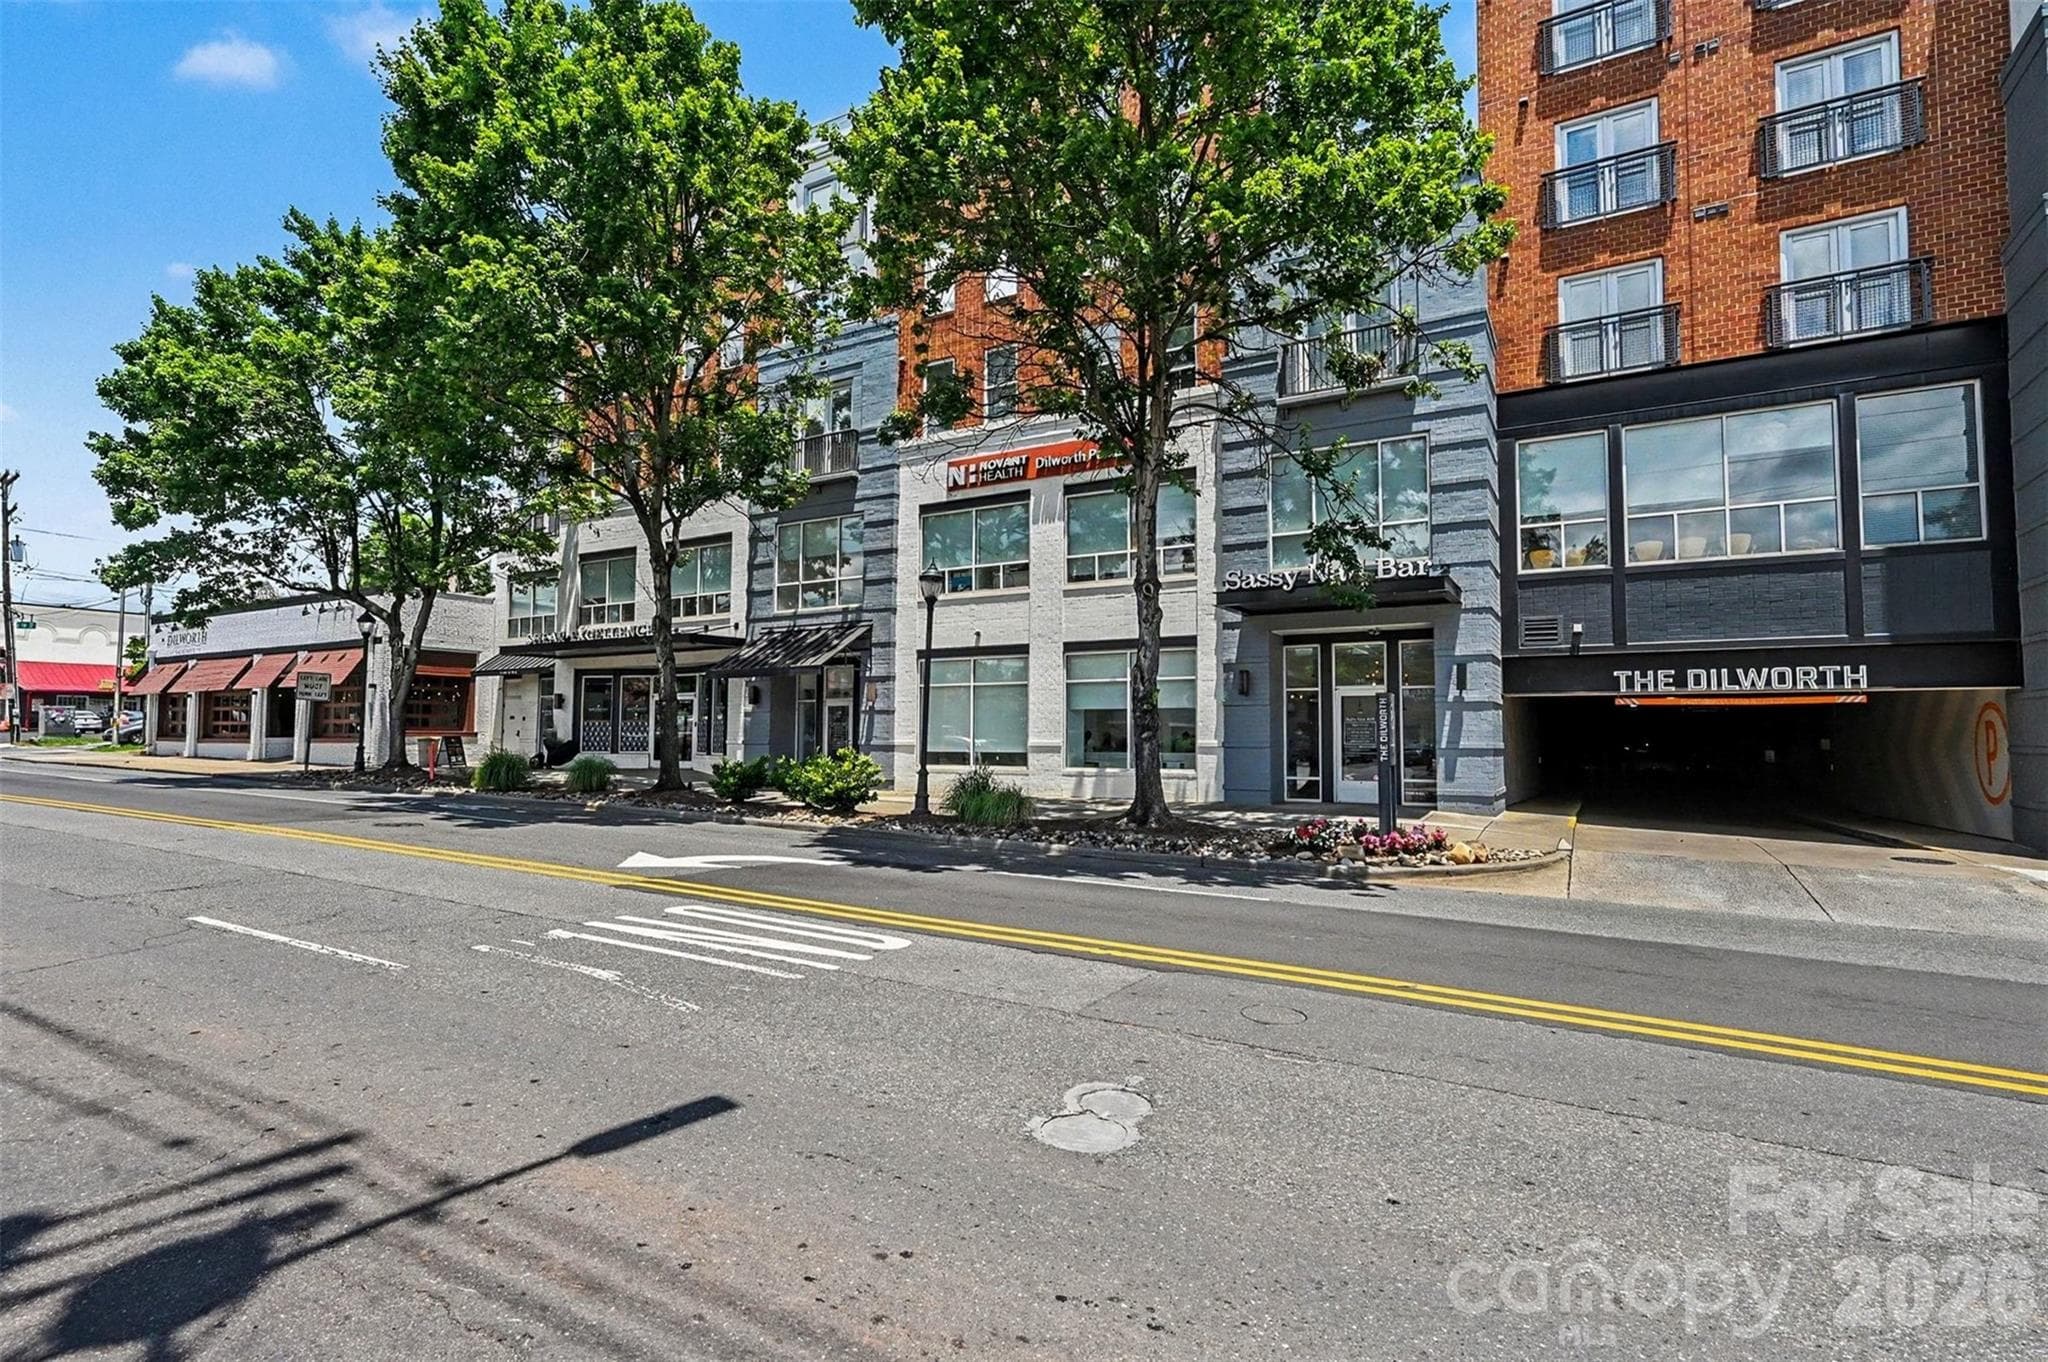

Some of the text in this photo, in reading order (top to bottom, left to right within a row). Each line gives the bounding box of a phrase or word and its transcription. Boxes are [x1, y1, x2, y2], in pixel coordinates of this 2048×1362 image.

[980, 455, 1028, 471] NOVANT
[1035, 451, 1086, 470] Dilworth
[980, 467, 1023, 482] HEALTH
[1224, 569, 1300, 591] Sassy
[1375, 557, 1432, 580] Bar
[167, 630, 208, 647] DILWORTH
[1613, 665, 1868, 693] THE DILWORTH
[1379, 697, 1389, 762] THE DILWORTH
